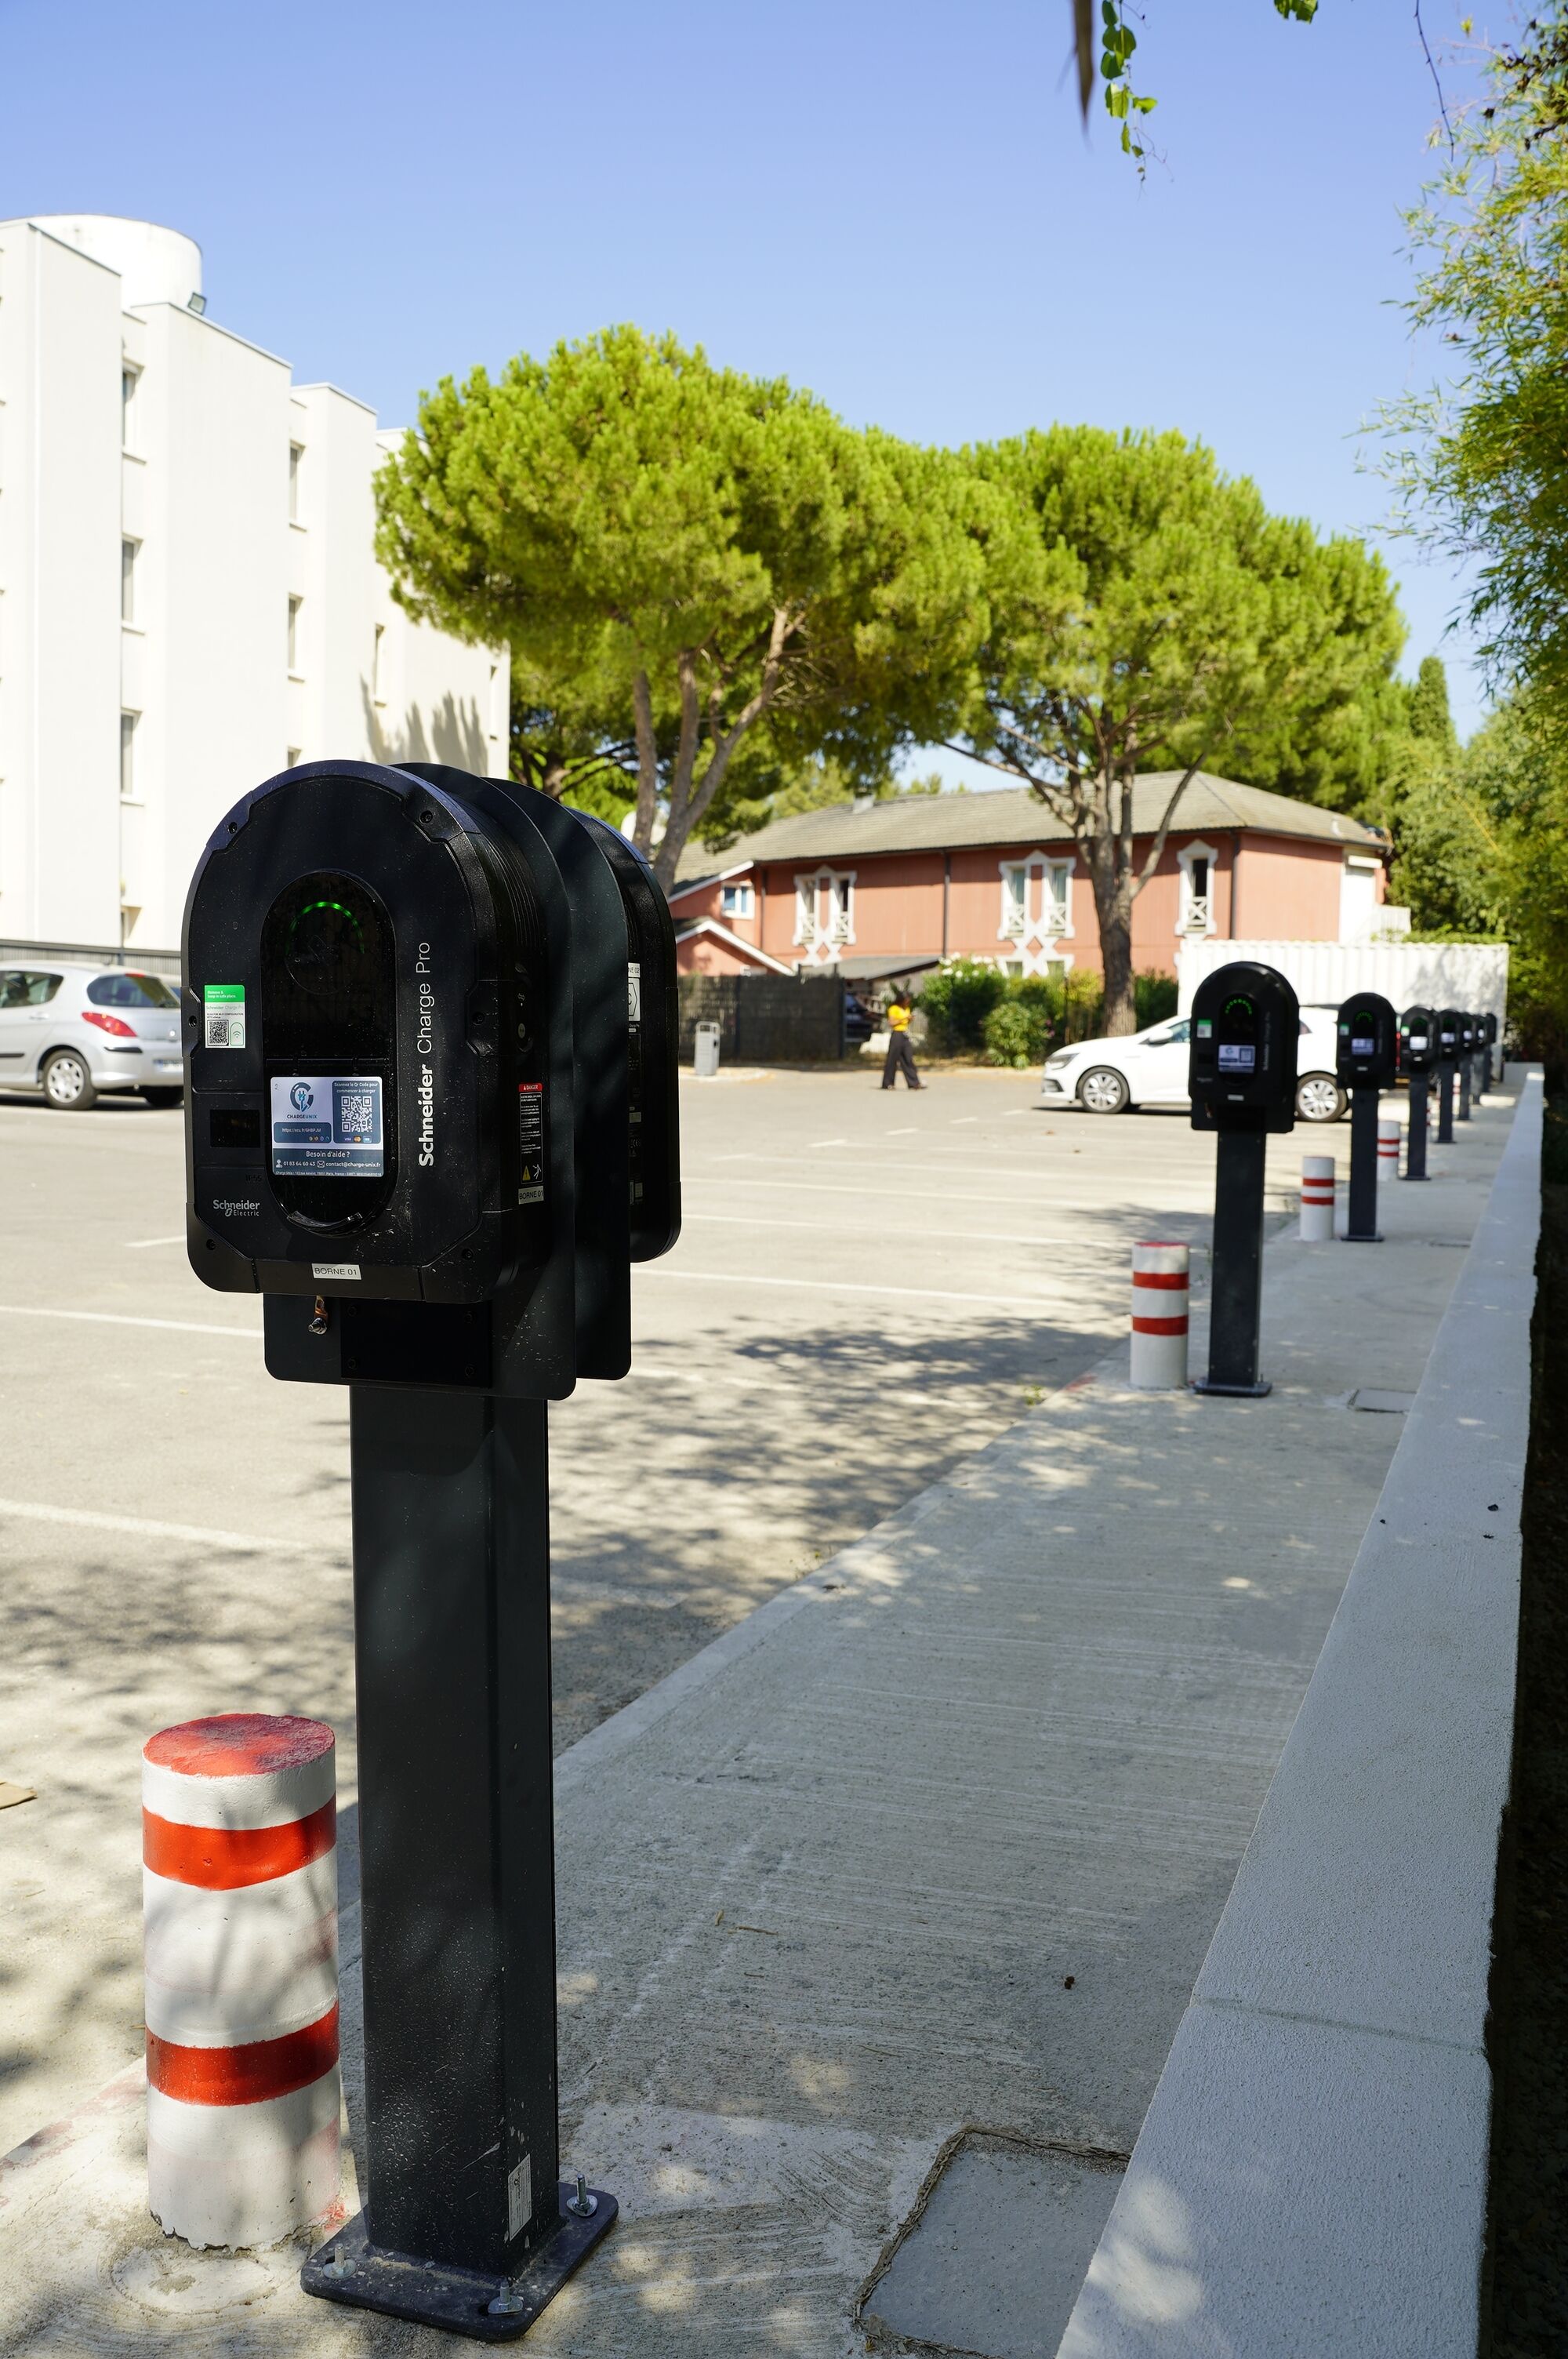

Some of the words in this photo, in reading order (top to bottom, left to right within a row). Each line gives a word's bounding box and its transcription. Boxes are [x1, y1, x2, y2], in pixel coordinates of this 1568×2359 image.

[416, 943, 430, 972] Pro
[416, 983, 435, 1054] Charge
[418, 1063, 434, 1166] Schneider
[212, 1199, 260, 1210] Schneider
[520, 1190, 537, 1200] BORNE
